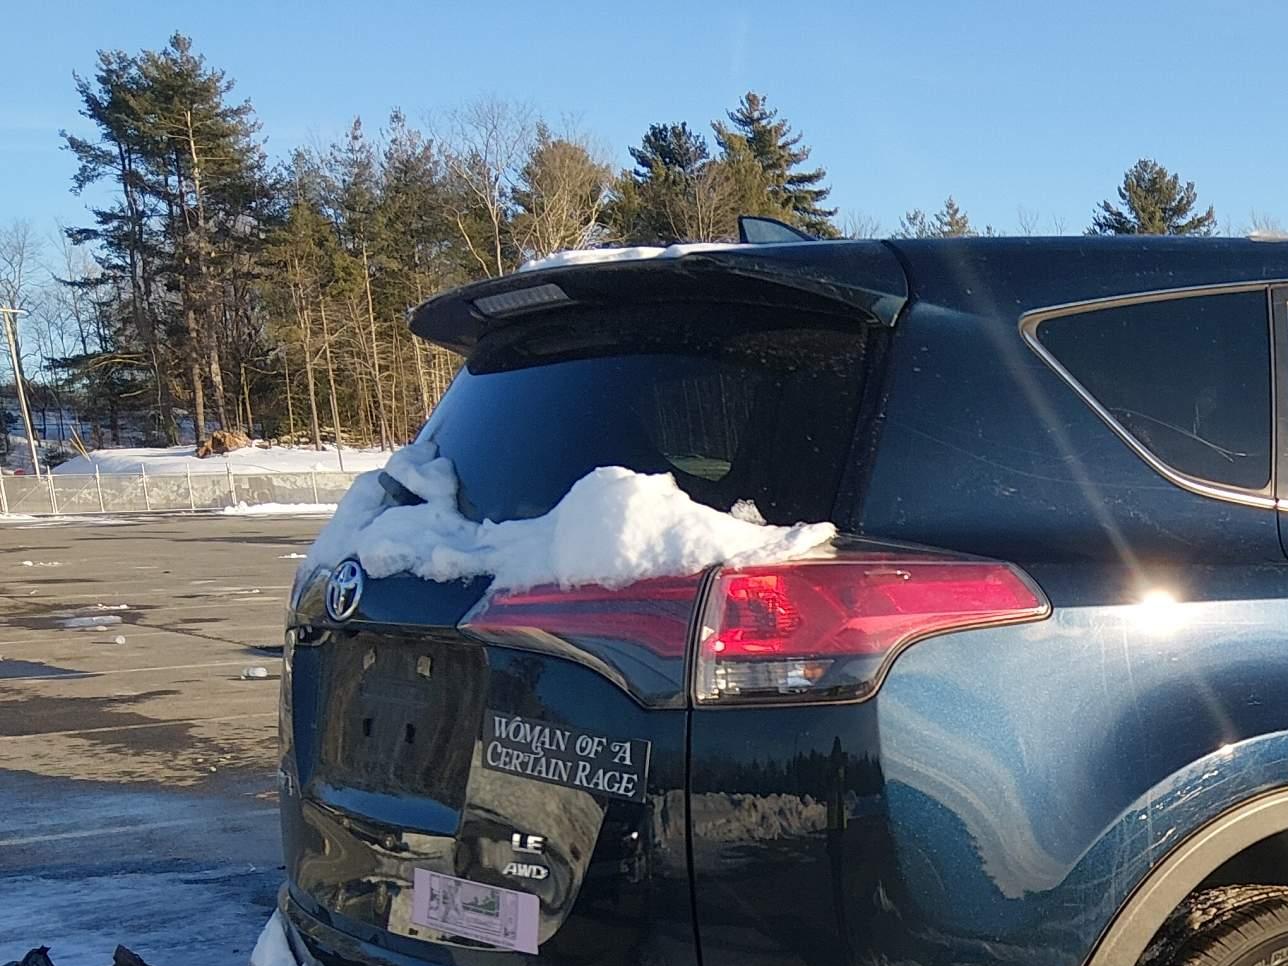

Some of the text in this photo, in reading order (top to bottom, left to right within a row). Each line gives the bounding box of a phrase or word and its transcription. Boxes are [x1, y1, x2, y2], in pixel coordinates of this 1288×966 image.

[494, 716, 633, 765] WOMAN OF A
[487, 741, 638, 797] CERTAIN RAGE
[512, 833, 544, 855] LE
[502, 862, 549, 880] AWD
